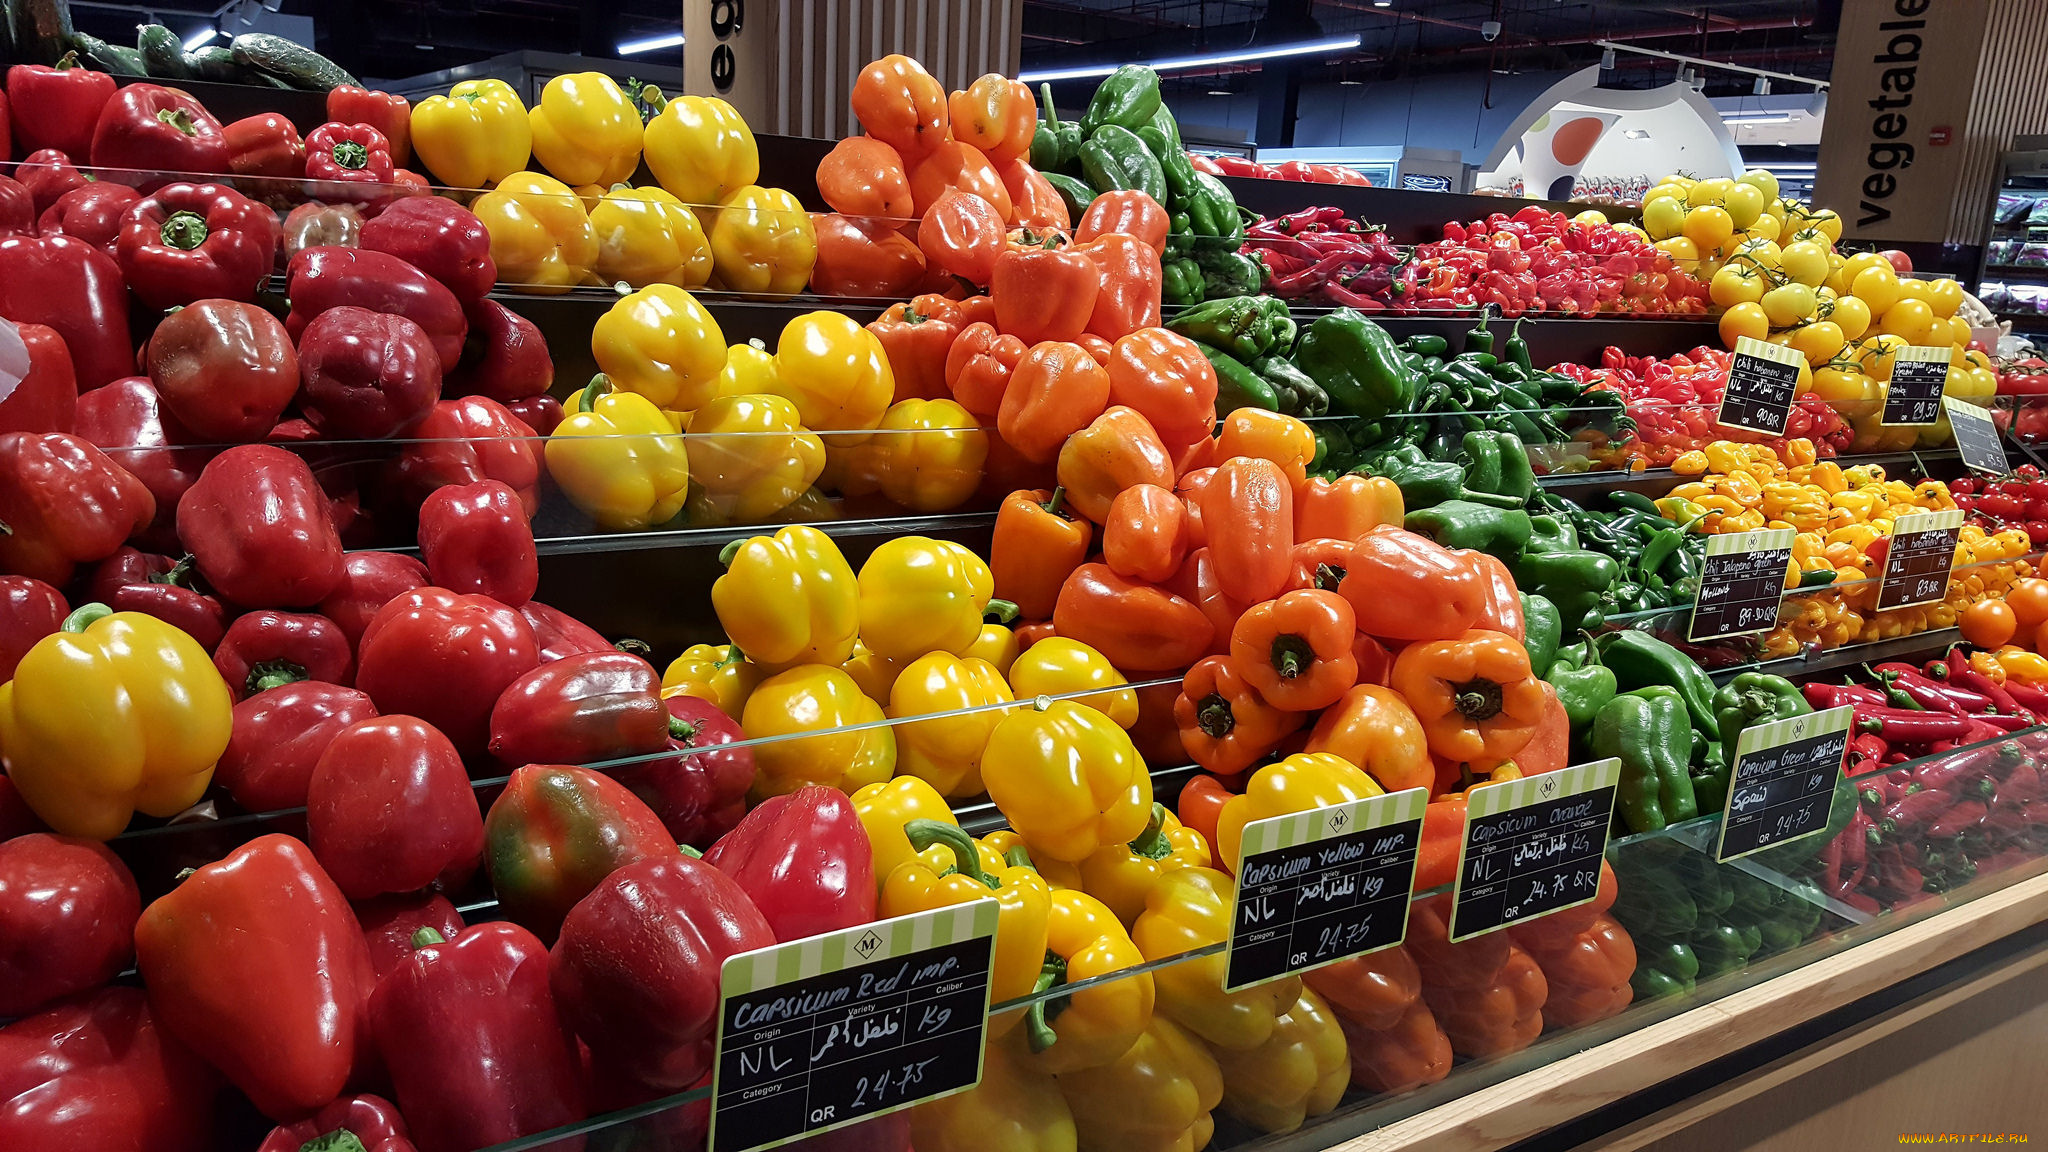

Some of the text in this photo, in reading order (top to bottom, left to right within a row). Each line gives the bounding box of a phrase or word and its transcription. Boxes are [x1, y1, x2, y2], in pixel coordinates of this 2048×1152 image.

[711, 0, 744, 91] eg
[1738, 756, 1777, 779] Capsicum
[1781, 750, 1805, 766] Green
[1544, 782, 1552, 792] M
[1334, 816, 1343, 826] M
[1759, 802, 1814, 844] QR 24.75
[1532, 832, 1547, 840] Variety
[1319, 842, 1364, 866] Yellow
[1472, 855, 1501, 881] NL
[1260, 856, 1398, 894] Origin Variety Caliber
[1472, 887, 1493, 897] Category
[1505, 906, 1518, 918] QR
[1574, 870, 1596, 891] QR
[1245, 897, 1275, 925] NL
[861, 938, 876, 950] M
[1250, 930, 1275, 942] Category
[1291, 913, 1372, 965] QR 24.75
[734, 986, 850, 1029] Capsicum
[856, 962, 908, 999] Red
[754, 981, 963, 1041] Origin Variety Caliber
[740, 1046, 792, 1076] NL
[742, 1082, 782, 1100] Category
[810, 1056, 940, 1123] QR 24.75
